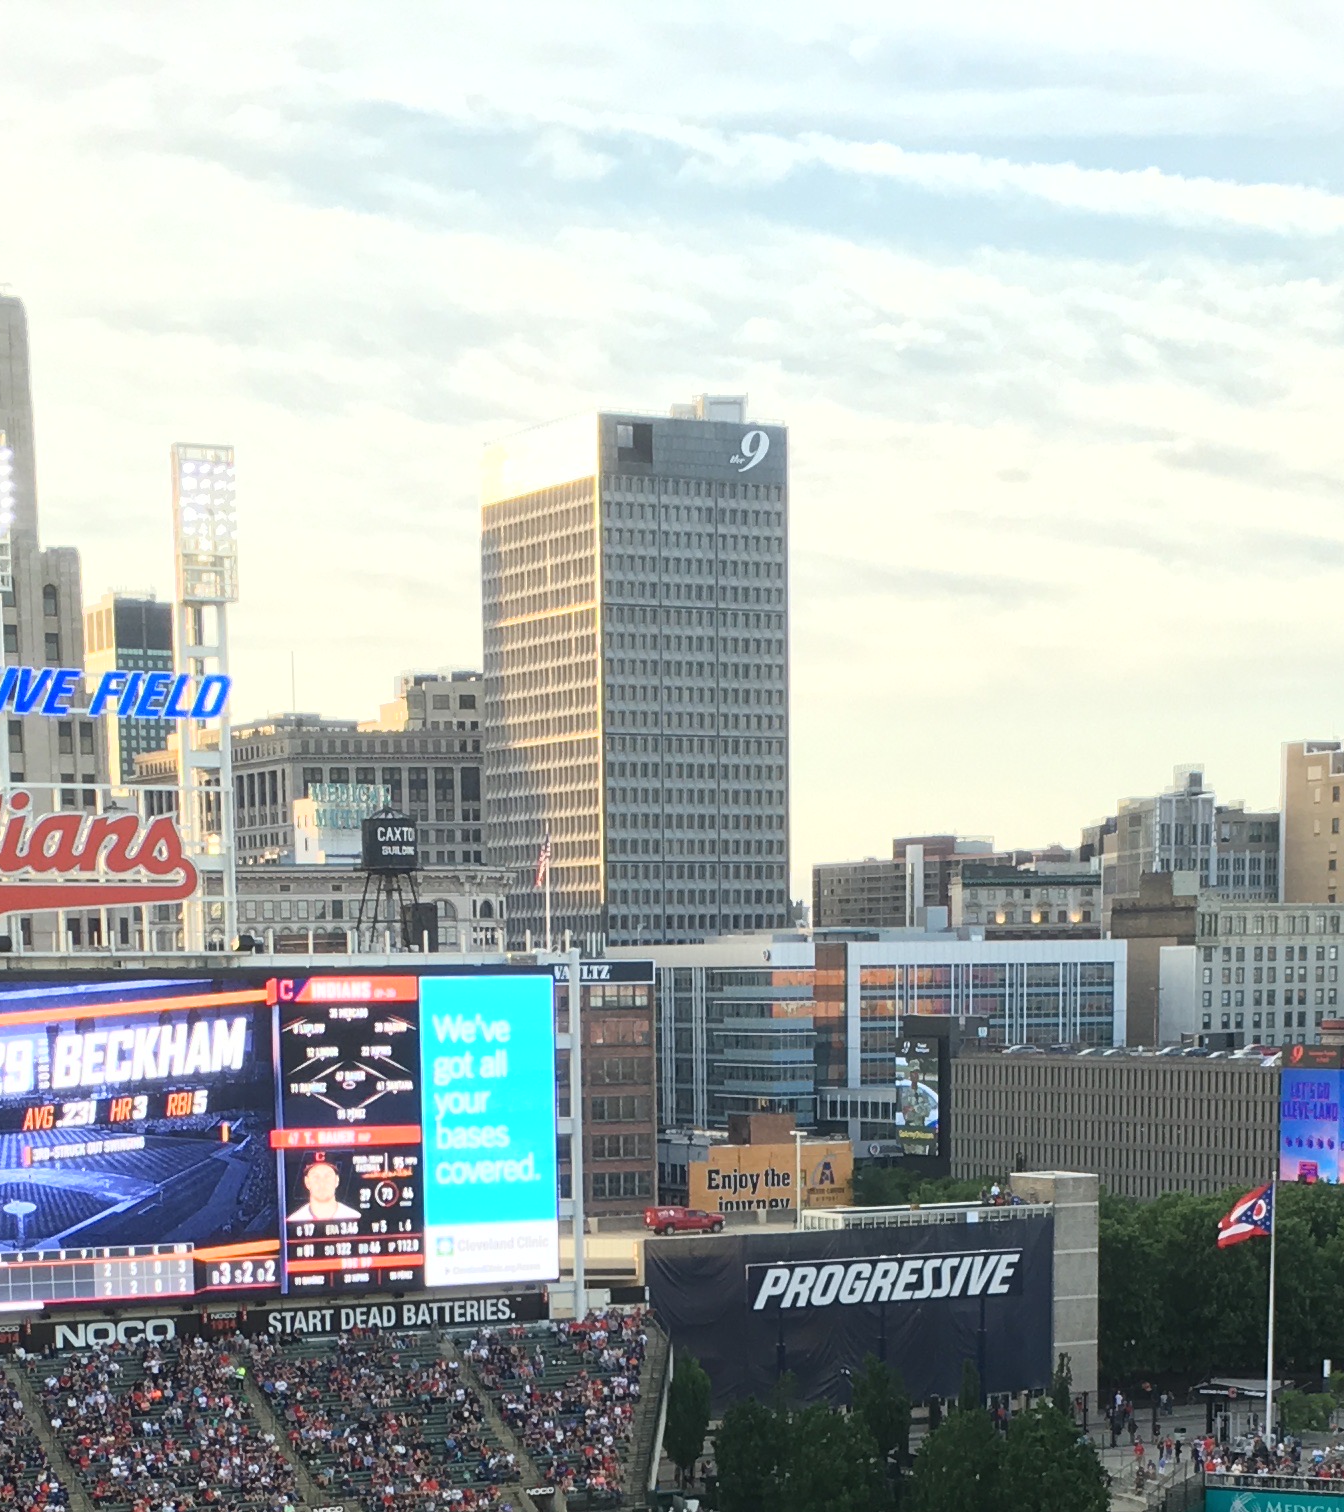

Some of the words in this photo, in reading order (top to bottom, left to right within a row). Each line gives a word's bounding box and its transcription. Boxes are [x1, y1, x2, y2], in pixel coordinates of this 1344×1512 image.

[739, 430, 770, 472] 9
[87, 669, 232, 719] FIELD
[554, 965, 610, 979] VALTZ
[433, 1014, 510, 1042] We've
[52, 1018, 247, 1090] BECKHAM
[434, 1053, 473, 1086] got
[480, 1050, 507, 1078] all
[23, 1107, 54, 1131] AVG
[55, 1102, 96, 1128] .231
[109, 1102, 131, 1122] HR
[131, 1096, 148, 1119] 3
[166, 1095, 192, 1118] RBI
[192, 1092, 208, 1115] 5
[433, 1091, 490, 1121] your
[436, 1123, 510, 1149] bases
[436, 1153, 541, 1184] covered.
[707, 1169, 760, 1195] Enjoy
[764, 1168, 790, 1187] the
[753, 1252, 1022, 1310] PROGRESSIVE
[210, 1311, 237, 1320] NOCO
[210, 1320, 237, 1330] 1914
[267, 1309, 335, 1335] START
[337, 1307, 398, 1330] DEAD
[402, 1296, 516, 1326] BATTERIES.
[56, 1318, 175, 1349] NOCO
[525, 1486, 555, 1496] NOCO
